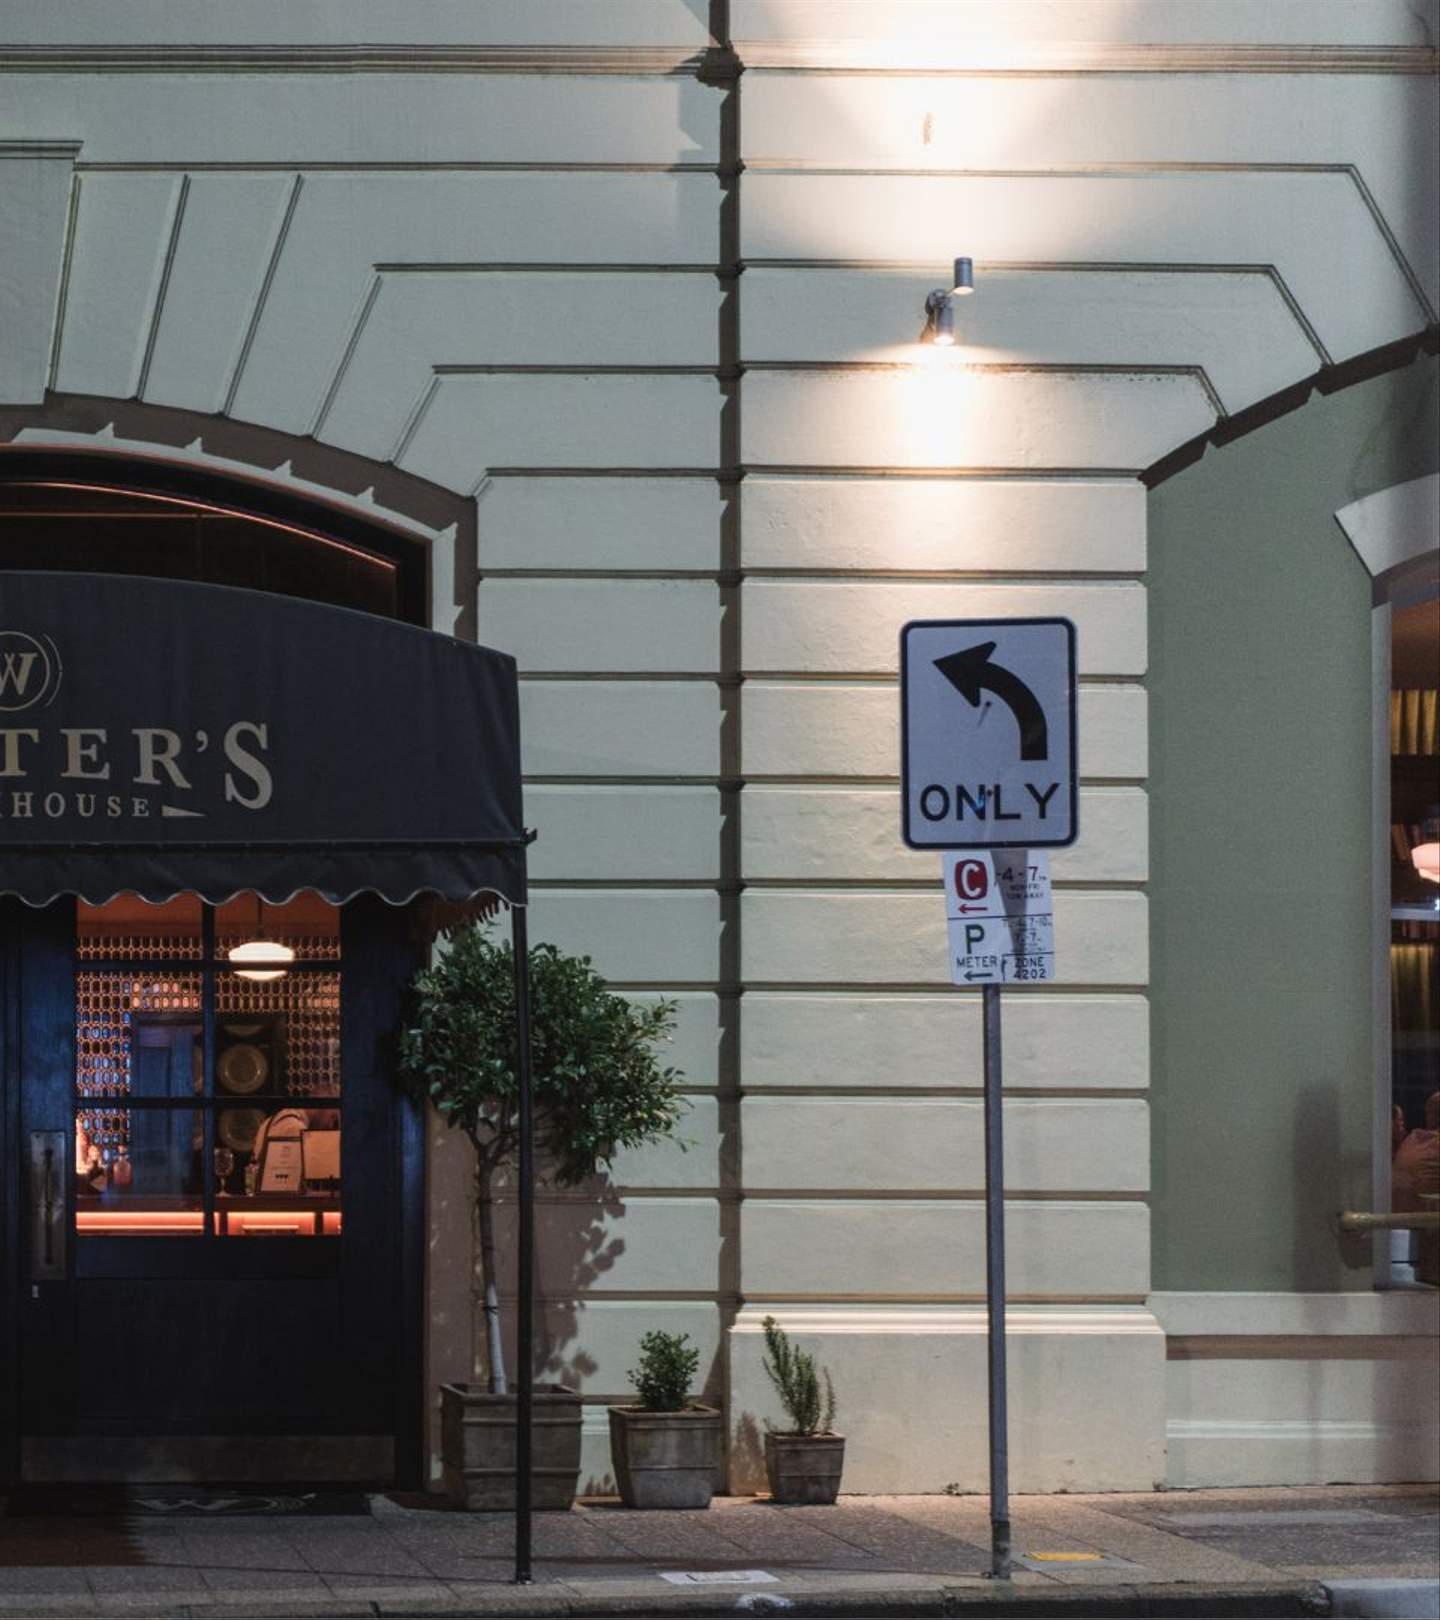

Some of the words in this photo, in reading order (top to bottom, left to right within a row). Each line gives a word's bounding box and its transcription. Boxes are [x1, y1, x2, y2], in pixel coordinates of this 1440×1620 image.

[919, 782, 1061, 822] ONLY
[961, 862, 982, 898] C
[965, 924, 985, 955] P
[956, 955, 998, 969] METER
[1014, 956, 1045, 969] ZONE
[1013, 968, 1047, 980] 4202
